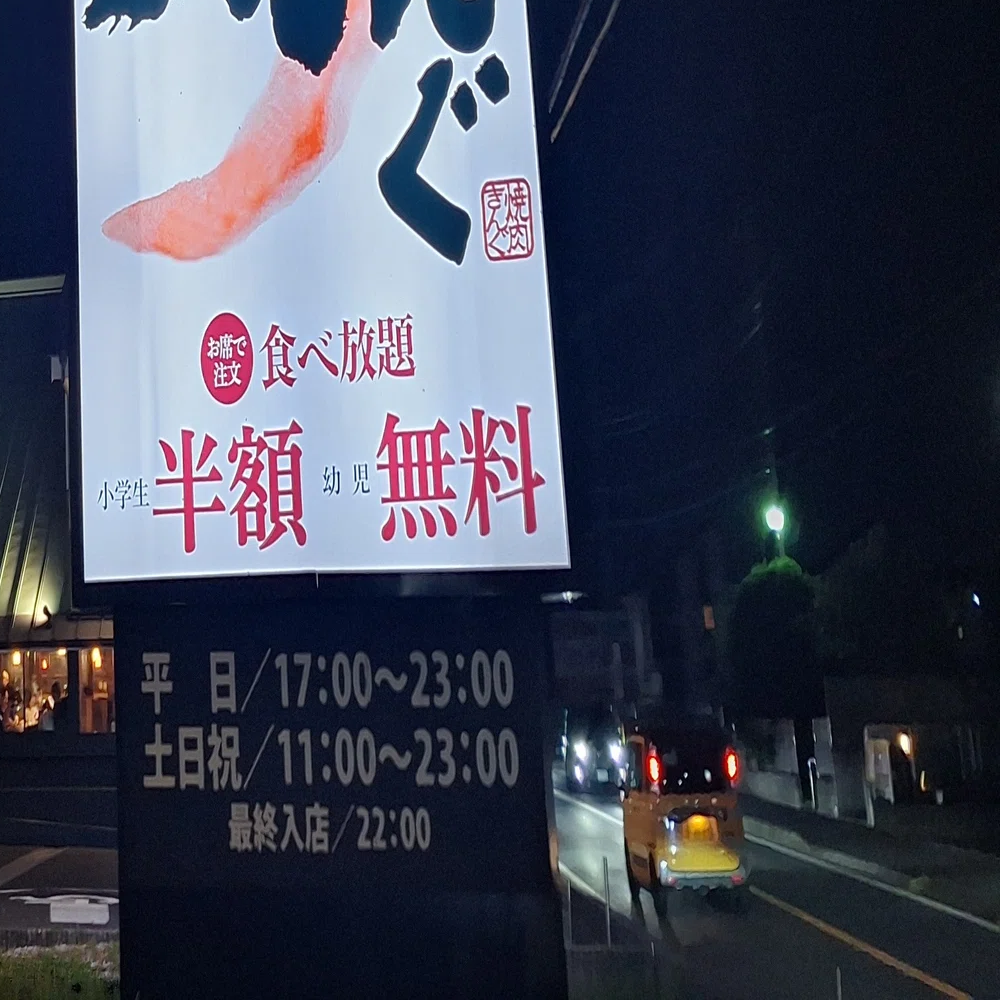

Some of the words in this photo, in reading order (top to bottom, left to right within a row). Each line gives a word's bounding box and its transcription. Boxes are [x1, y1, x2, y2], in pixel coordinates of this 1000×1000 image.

[206, 332, 248, 360] お席で
[259, 313, 417, 391] 食べ放題
[213, 360, 243, 388] 注文
[97, 477, 150, 510] 小学生
[152, 419, 308, 554] 半額
[375, 404, 547, 543] 無料
